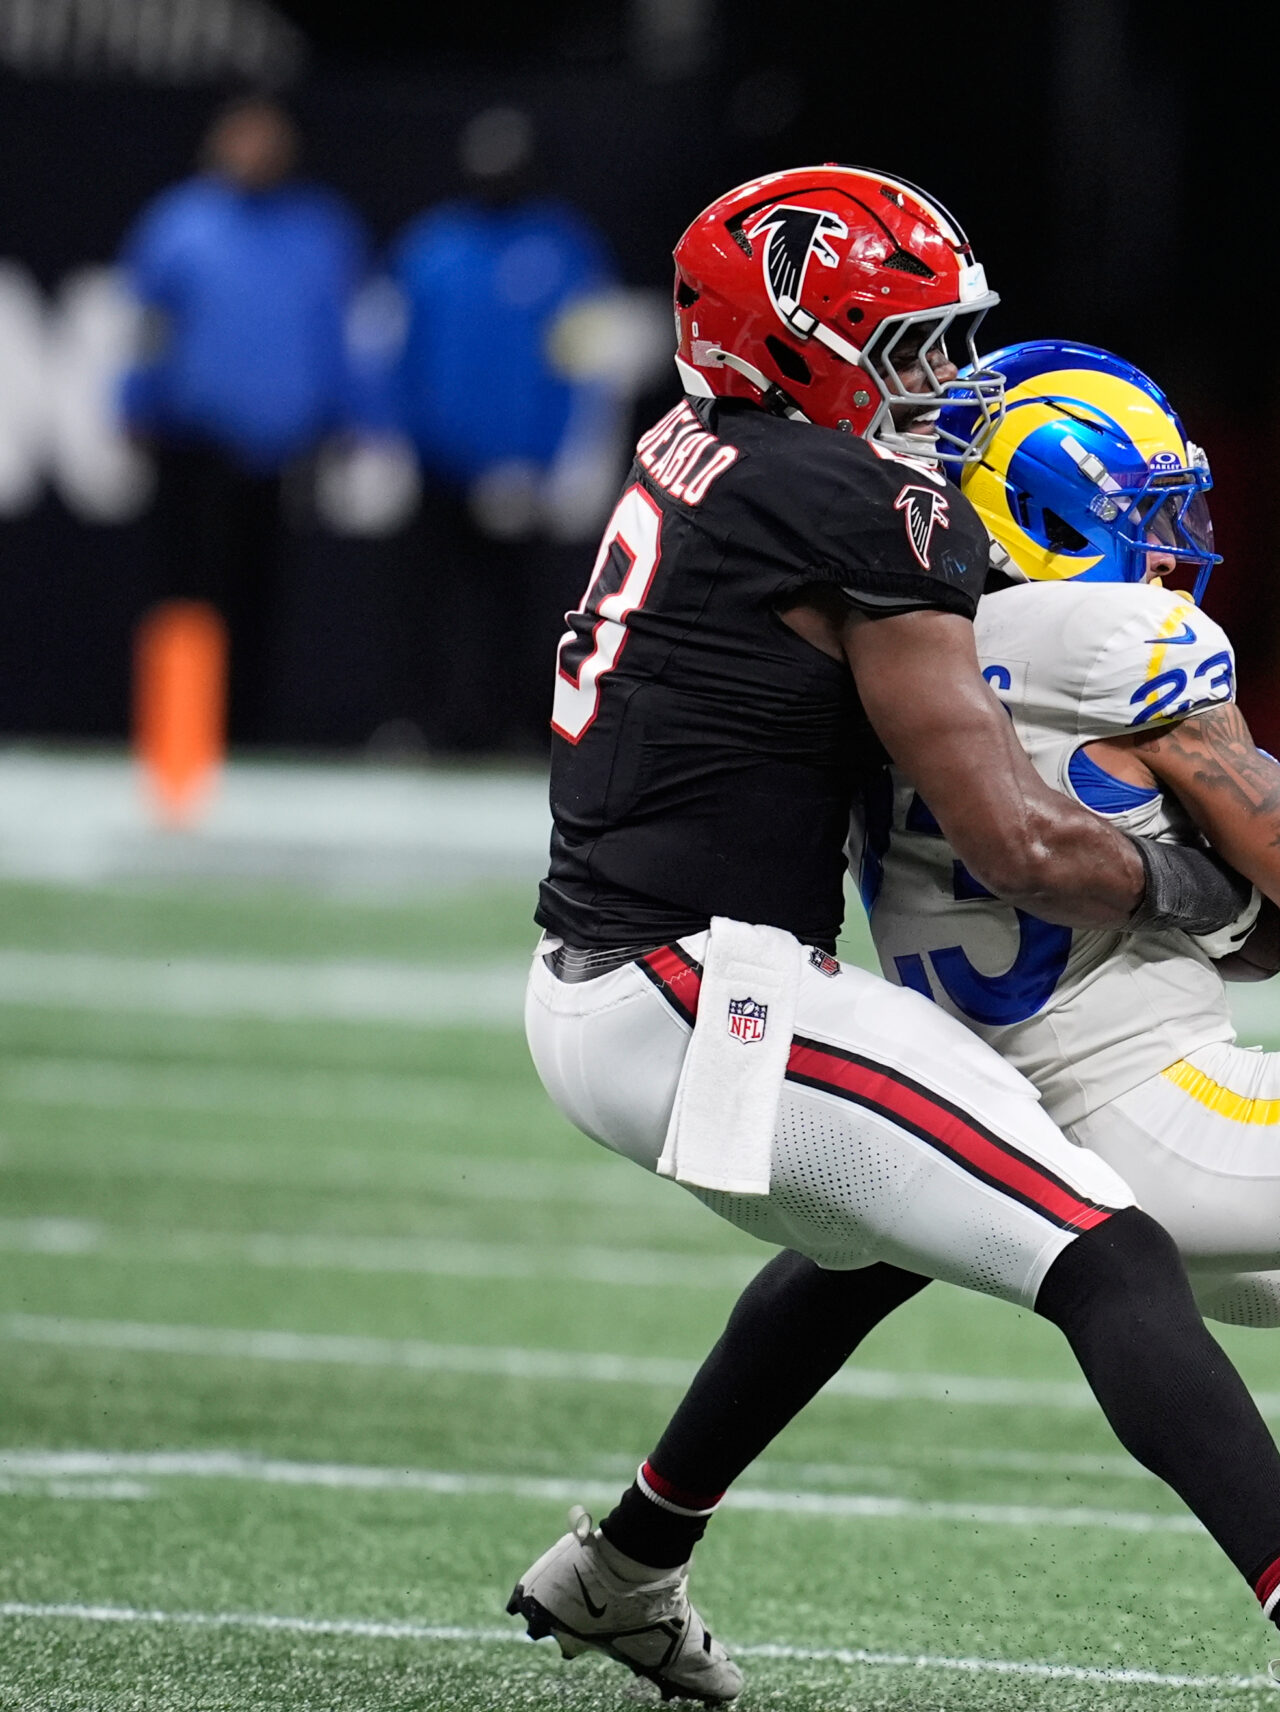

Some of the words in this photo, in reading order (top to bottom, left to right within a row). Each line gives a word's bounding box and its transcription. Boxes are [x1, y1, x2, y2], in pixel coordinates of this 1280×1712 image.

[637, 399, 739, 506] DEABLO
[1149, 463, 1181, 471] OAKLEY
[1129, 650, 1233, 727] 23
[730, 1015, 762, 1040] NFL
